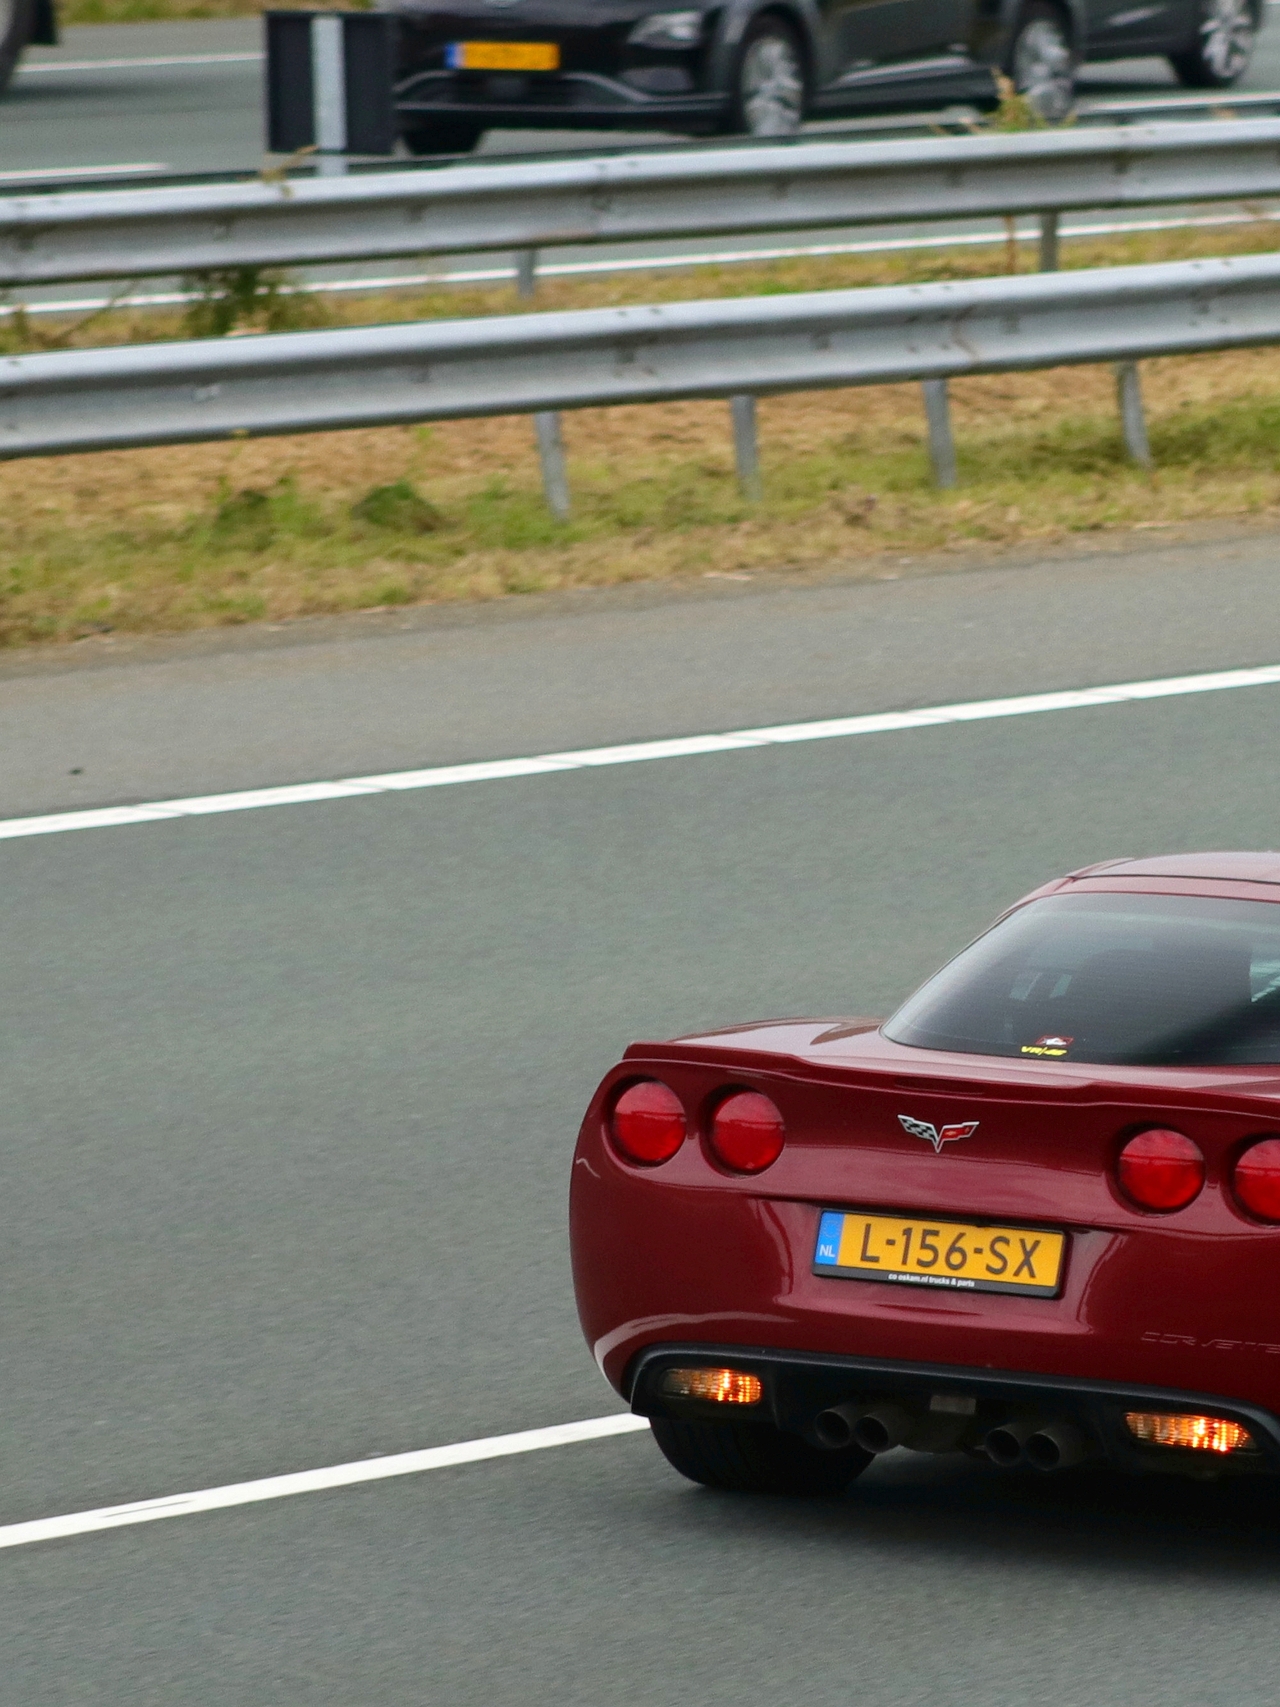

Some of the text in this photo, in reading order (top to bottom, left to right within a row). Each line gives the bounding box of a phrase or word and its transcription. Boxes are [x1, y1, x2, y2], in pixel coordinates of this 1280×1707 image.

[819, 1244, 836, 1258] NL
[860, 1223, 1041, 1279] L-156-SX
[929, 1276, 950, 1285] trucks
[957, 1279, 975, 1287] parts
